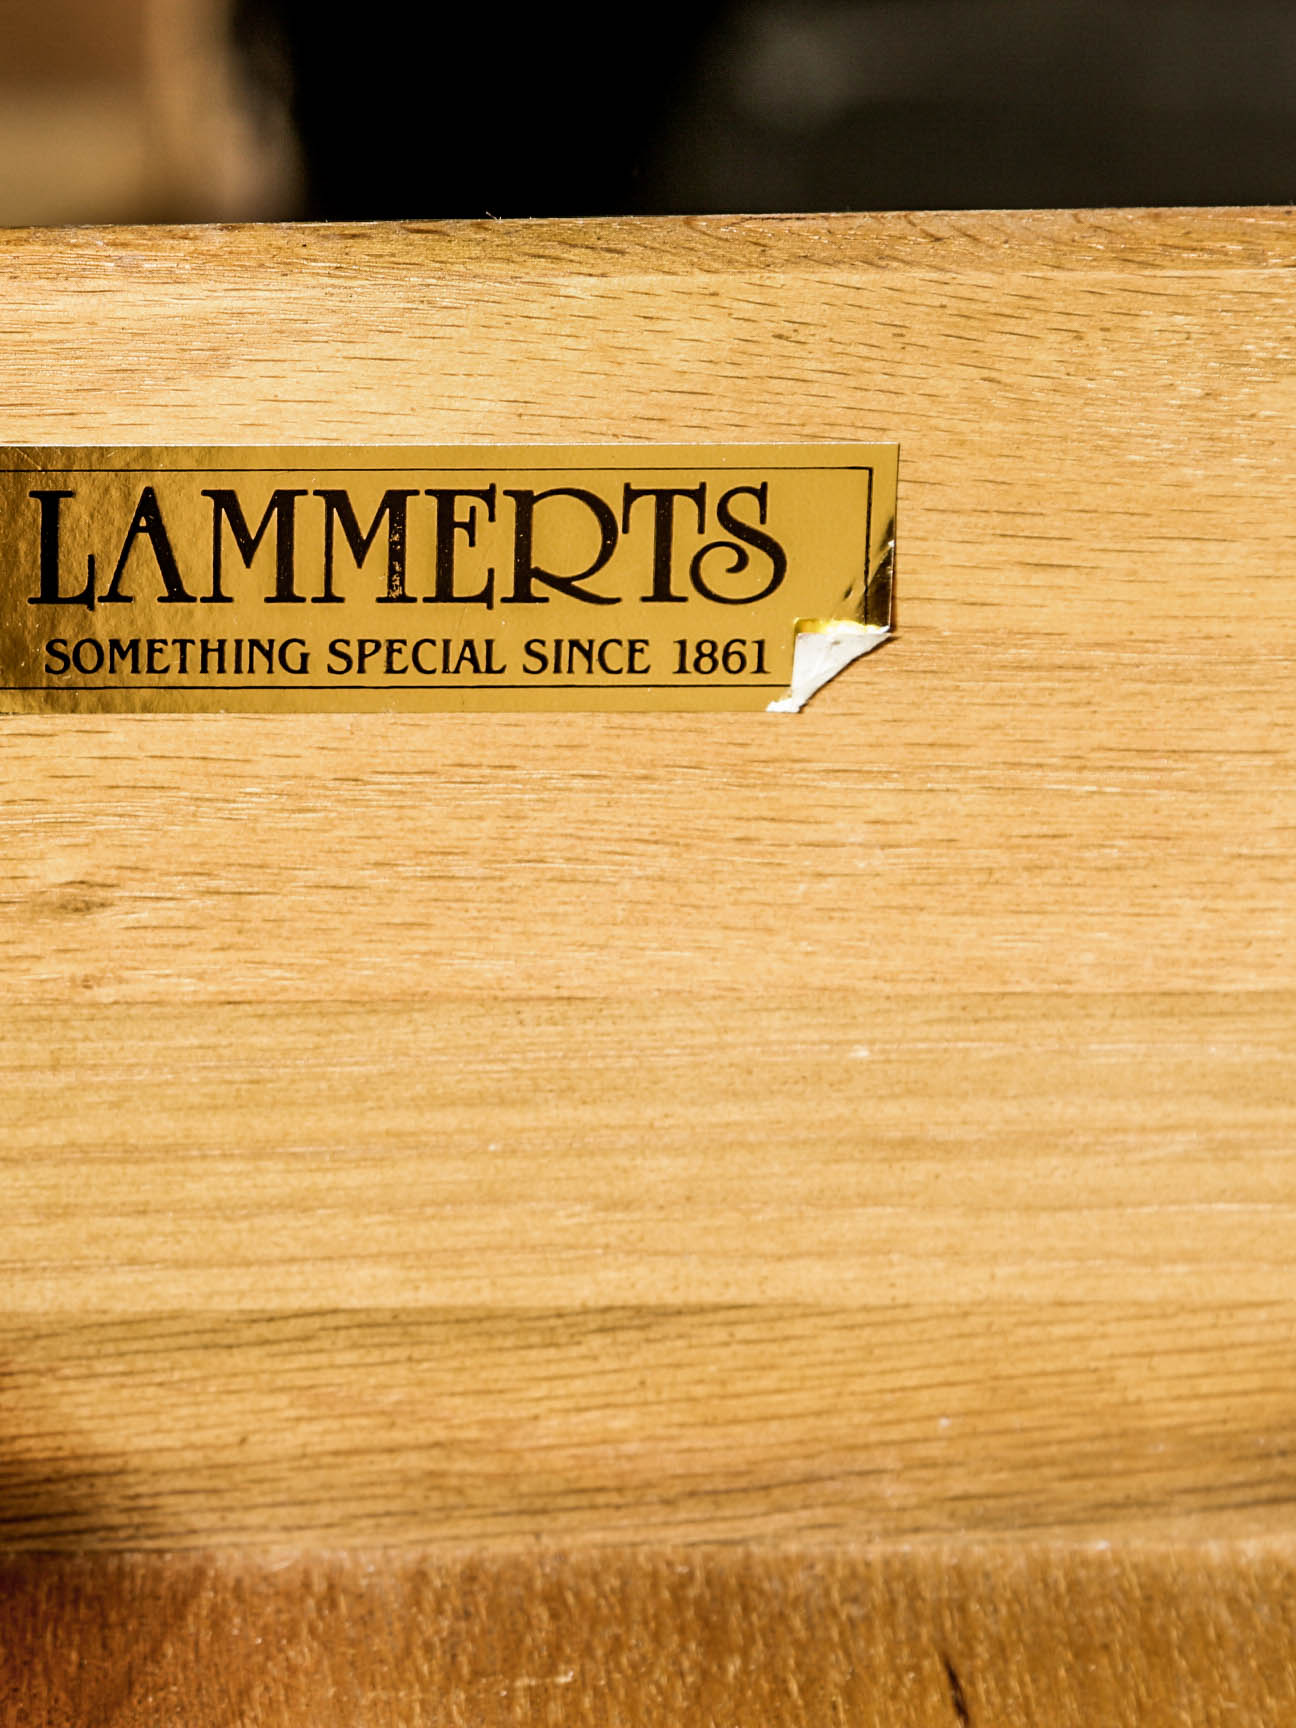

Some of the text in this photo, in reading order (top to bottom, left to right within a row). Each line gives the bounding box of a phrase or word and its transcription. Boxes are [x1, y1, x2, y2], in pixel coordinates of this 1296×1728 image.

[27, 481, 787, 611] LAMMERTS
[44, 638, 771, 675] SOMETHING SPECIAL SINCE 1861
